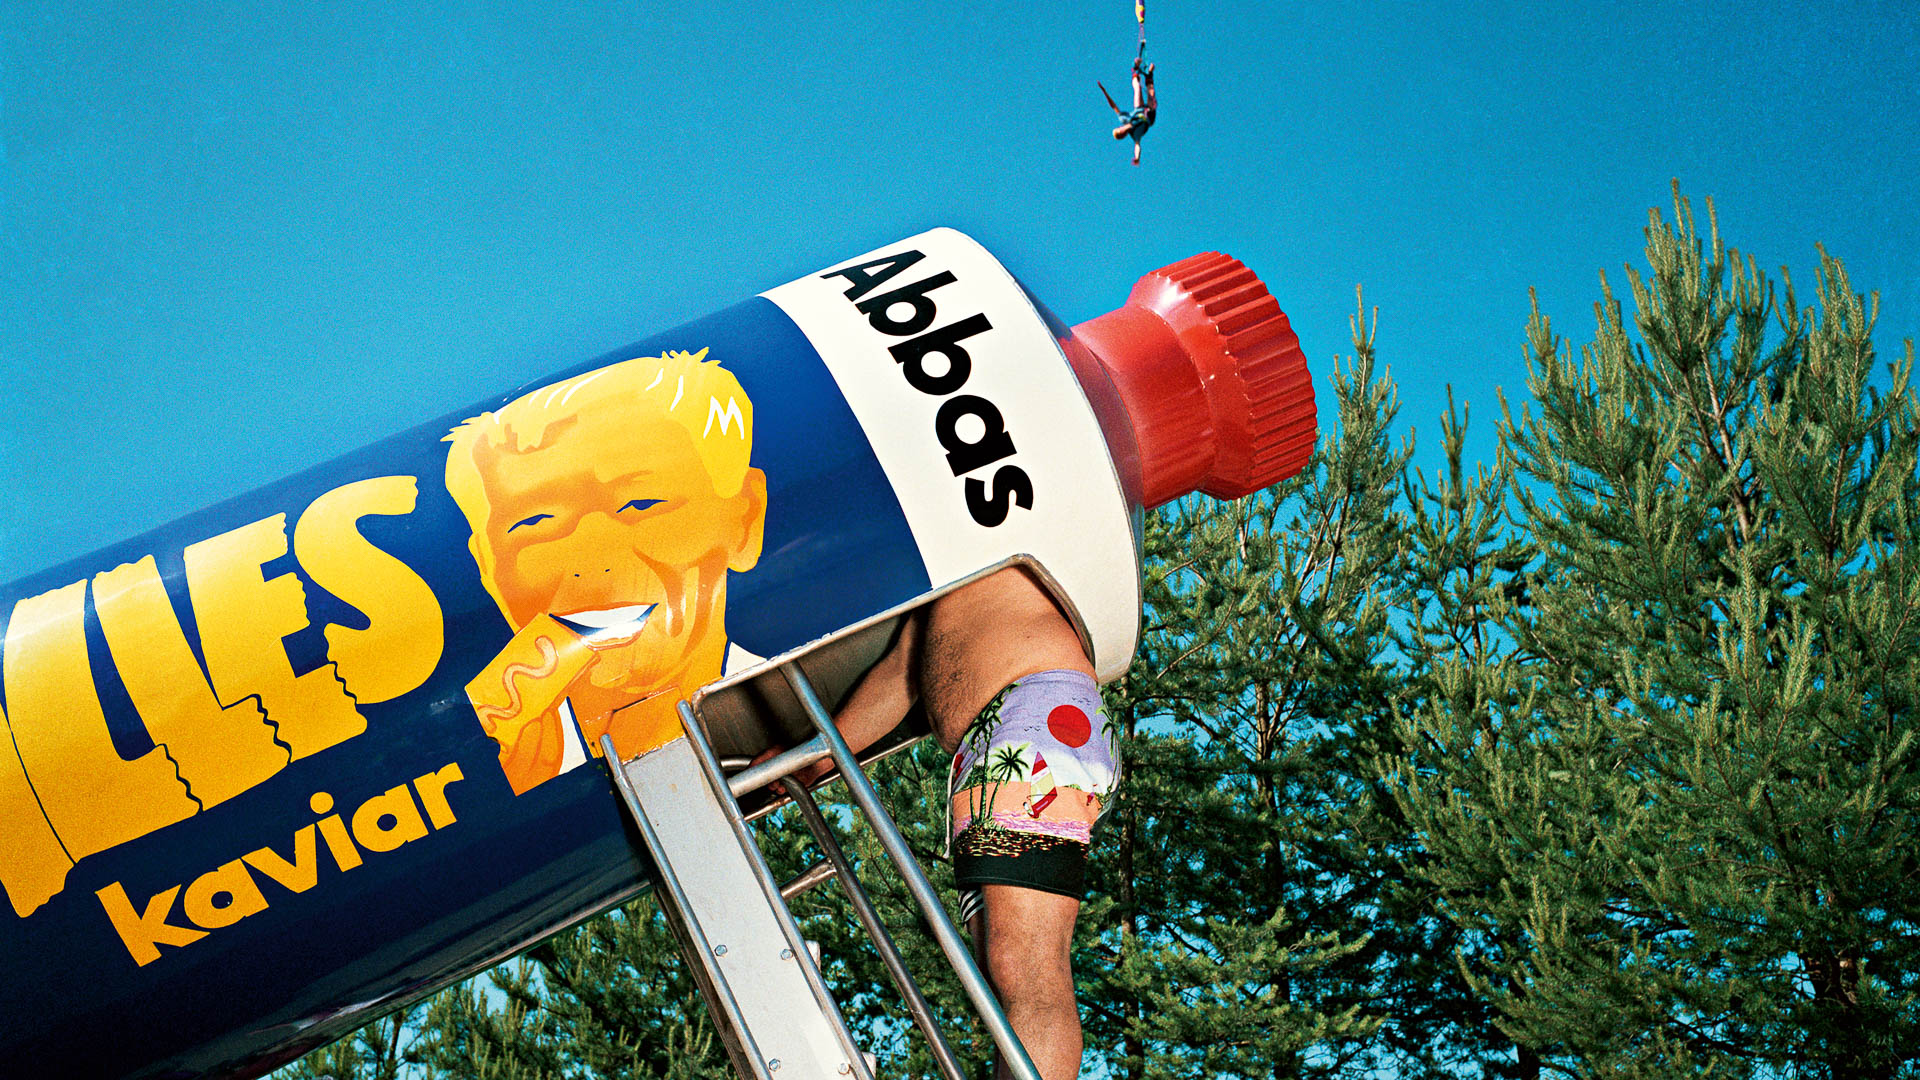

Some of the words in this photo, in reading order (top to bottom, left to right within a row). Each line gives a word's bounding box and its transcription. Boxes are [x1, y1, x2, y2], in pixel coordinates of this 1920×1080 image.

[819, 249, 1034, 528] Abbas
[0, 475, 444, 918] LLES
[95, 762, 465, 967] kaviar
